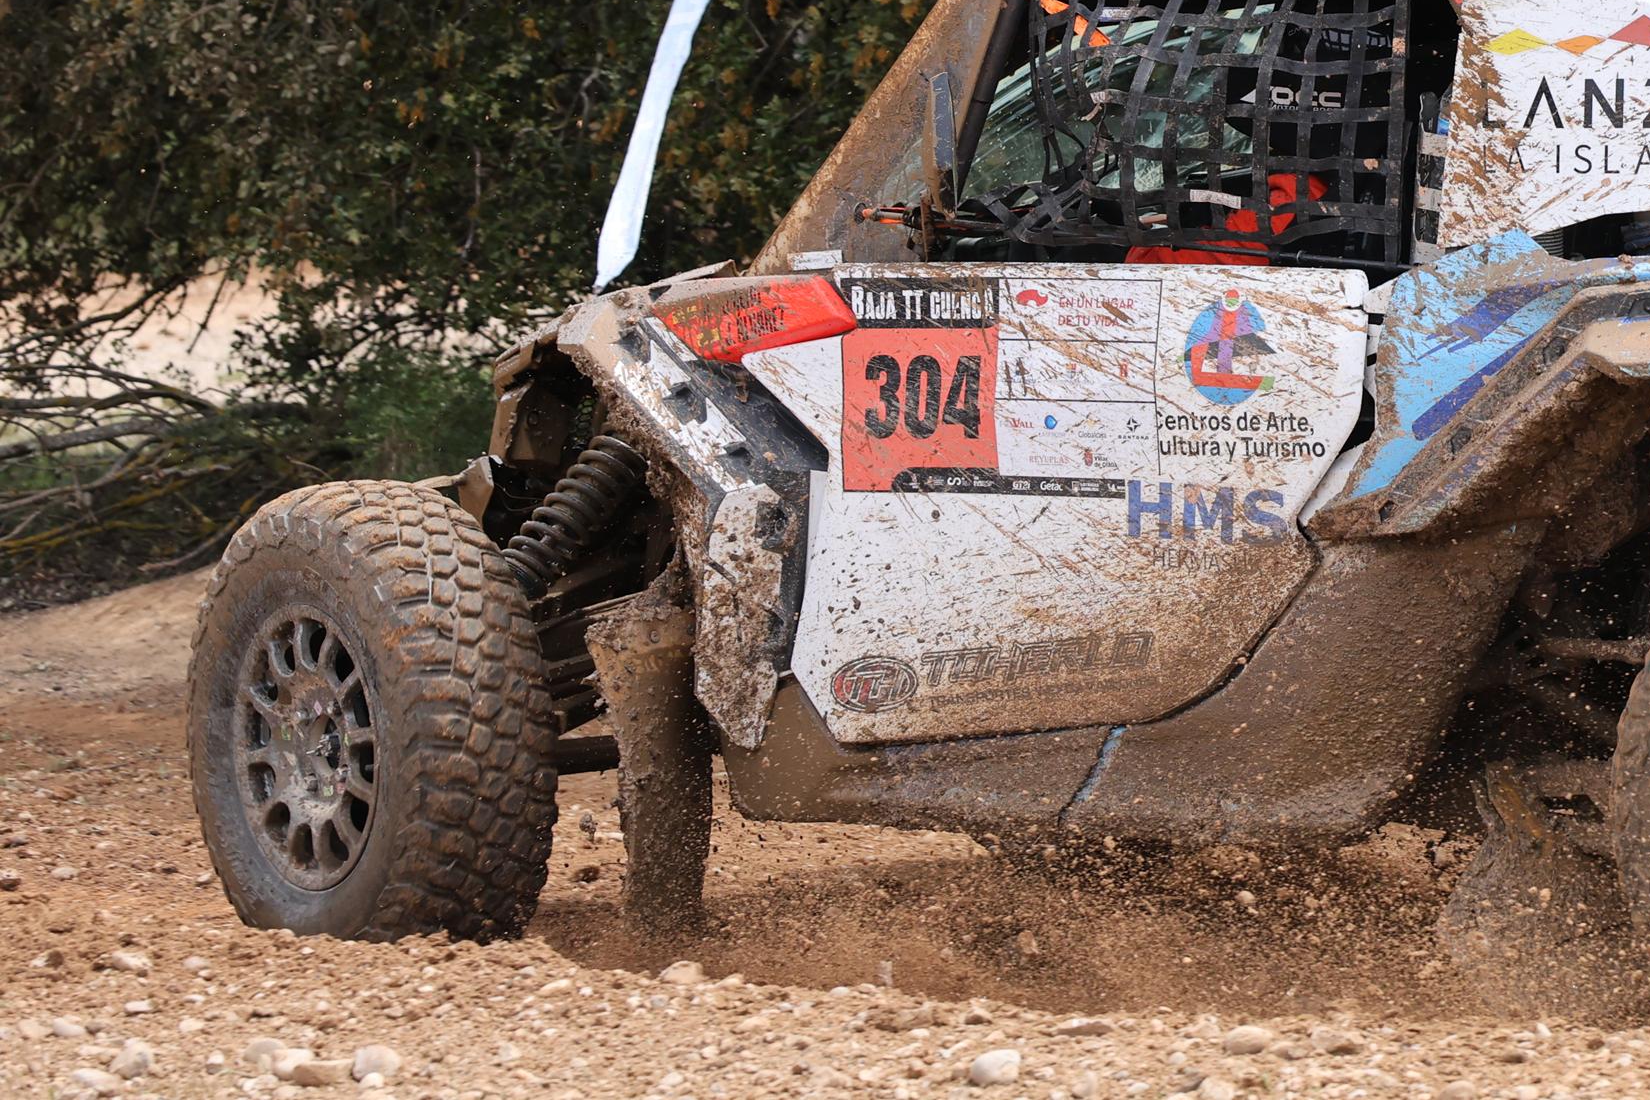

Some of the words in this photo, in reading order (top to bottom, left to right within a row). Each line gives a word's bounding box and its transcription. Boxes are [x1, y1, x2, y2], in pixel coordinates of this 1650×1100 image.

[1483, 144, 1528, 174] LA
[851, 285, 897, 320] BAJA
[902, 289, 924, 320] TT
[929, 285, 995, 320] CUENCA
[1059, 297, 1074, 308] EN
[1077, 297, 1094, 309] UN
[1058, 315, 1072, 326] DE
[1075, 315, 1090, 326] TU
[1093, 315, 1120, 327] VIDA
[864, 354, 981, 439] 304
[1236, 411, 1262, 432] de
[1266, 411, 1314, 436] Arte,
[1159, 435, 1221, 456] ultura
[1225, 440, 1237, 462] y
[1245, 436, 1326, 458] Turismo
[1040, 480, 1063, 492] Getac
[1128, 479, 1288, 546] HMS
